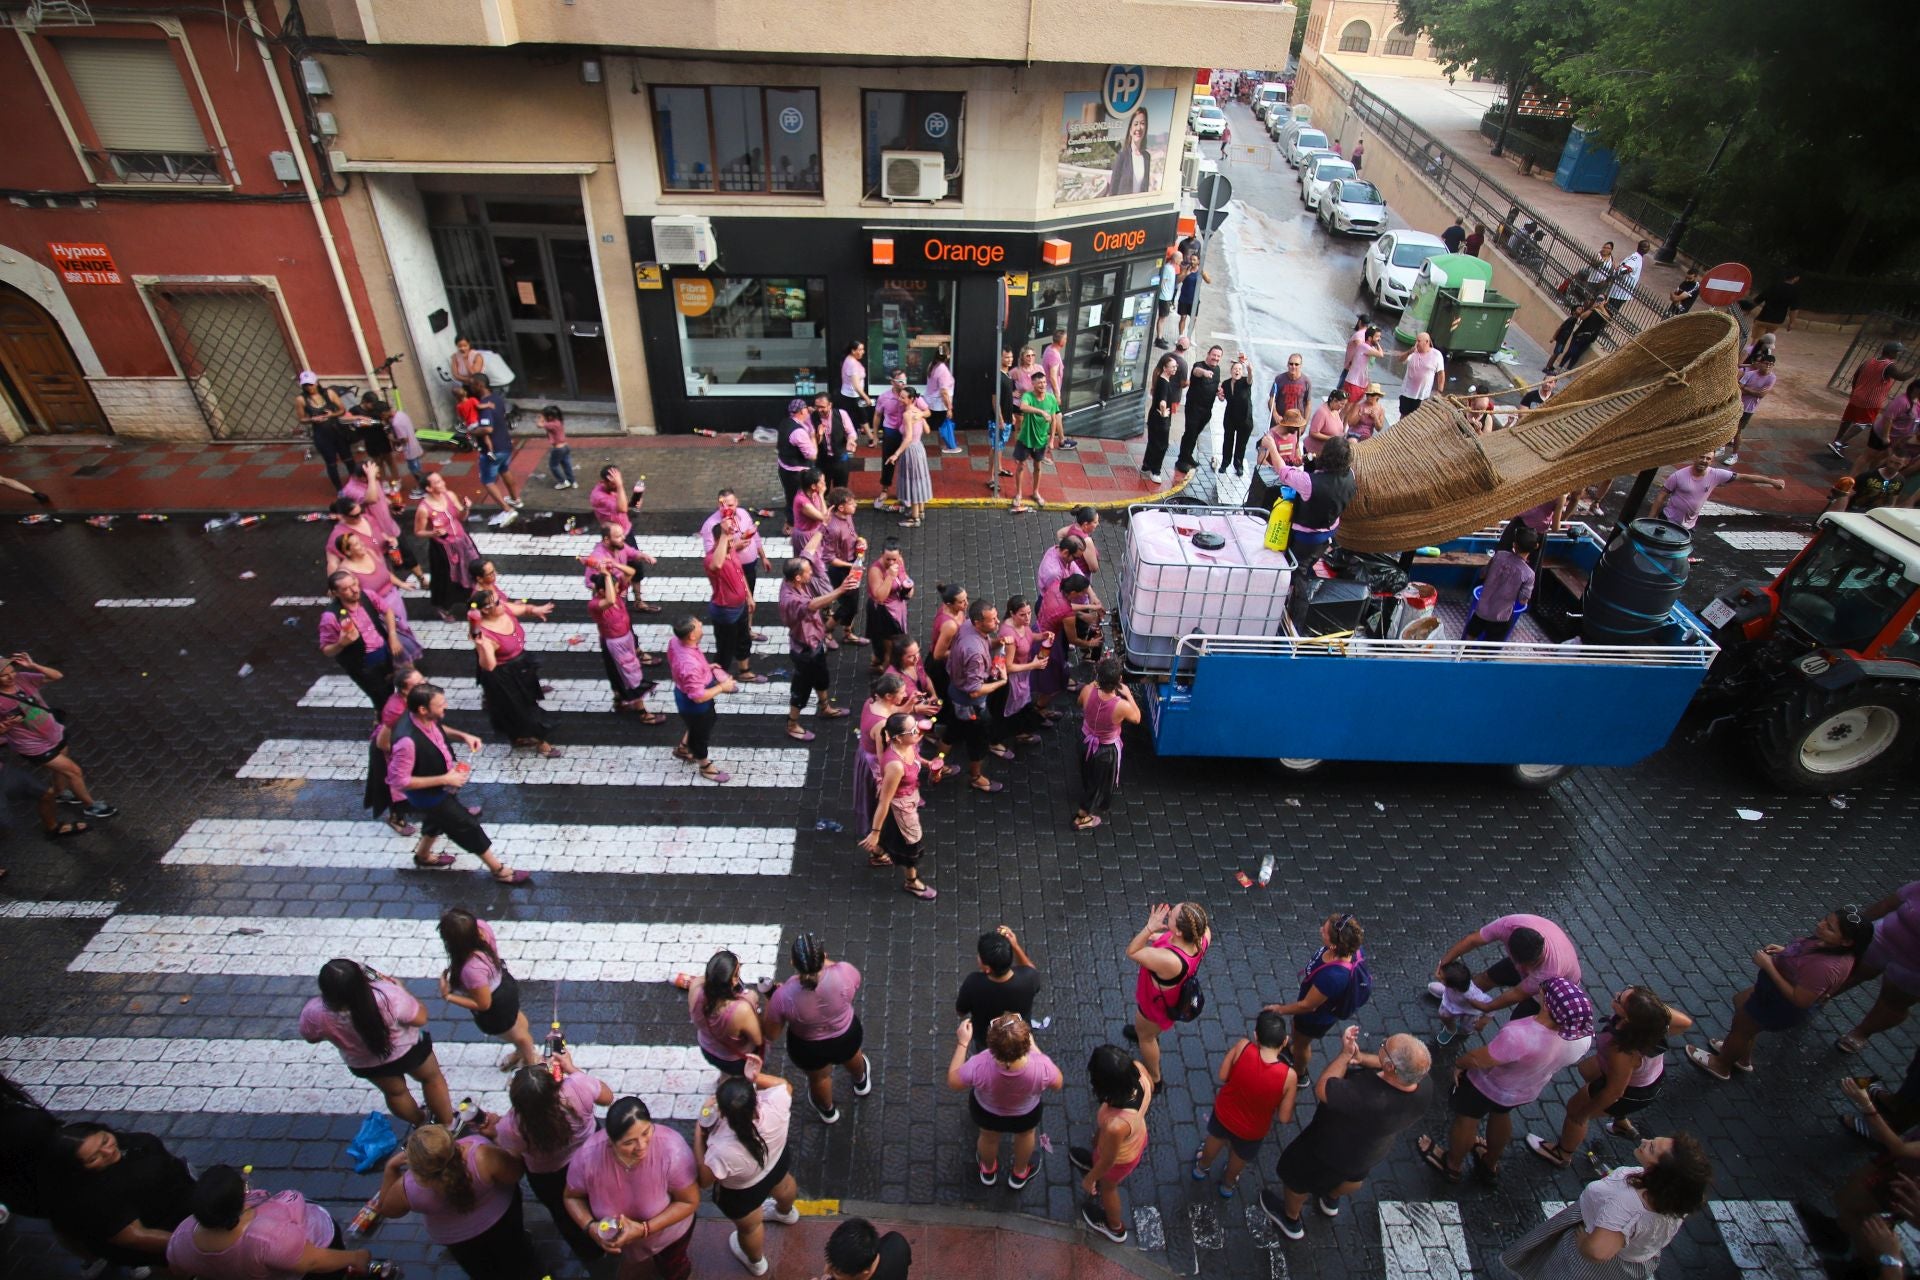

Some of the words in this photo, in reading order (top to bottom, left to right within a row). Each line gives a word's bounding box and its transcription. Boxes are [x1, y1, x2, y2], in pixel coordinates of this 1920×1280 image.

[1112, 73, 1140, 103] PP
[1094, 228, 1145, 252] Orange
[51, 244, 107, 259] Hypnos
[924, 239, 1004, 266] Orange
[58, 260, 115, 272] VENDE
[1803, 657, 1828, 674] 40
